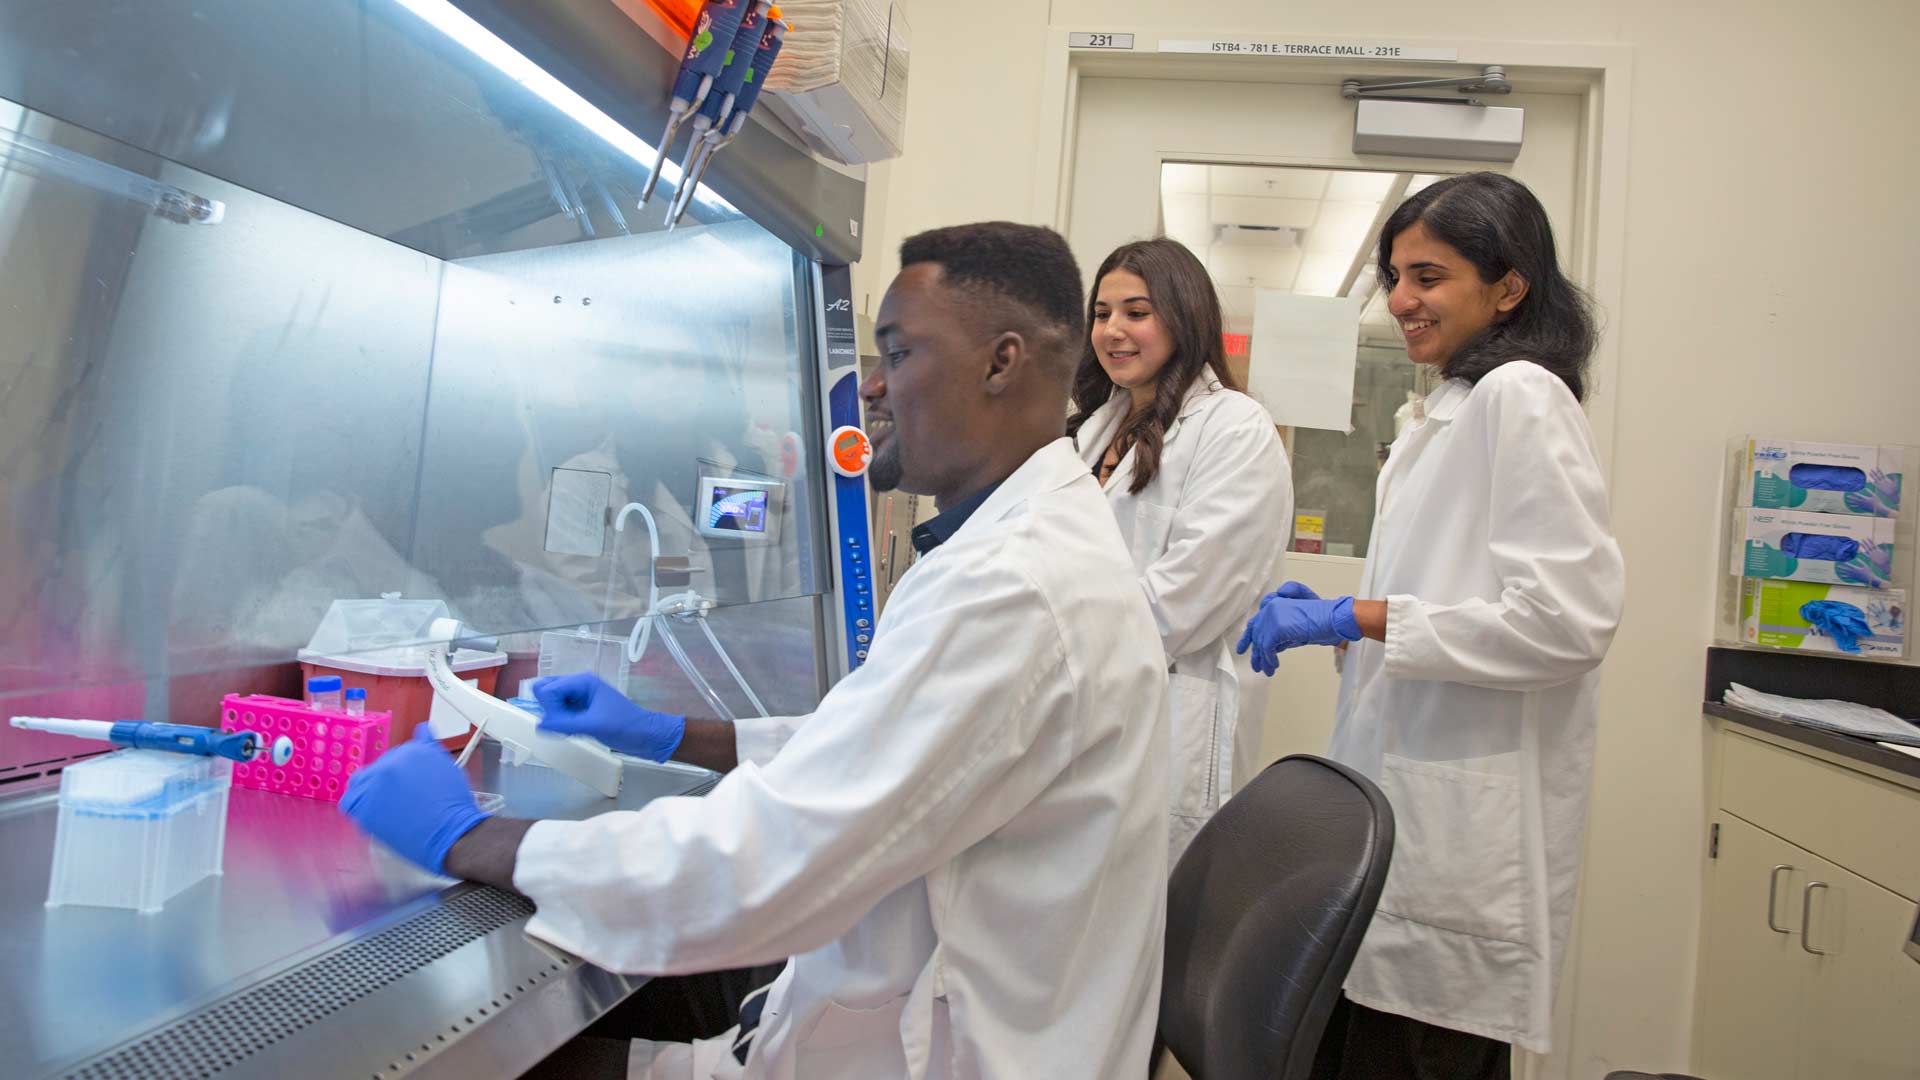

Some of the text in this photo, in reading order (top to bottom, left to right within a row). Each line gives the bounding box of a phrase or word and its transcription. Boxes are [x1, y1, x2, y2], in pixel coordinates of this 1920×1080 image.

[1089, 34, 1113, 46] 231
[1211, 42, 1240, 52] ISTB4
[1250, 43, 1268, 53] 781
[1272, 44, 1281, 53] E.
[1284, 45, 1332, 55] TERRACE
[1335, 46, 1365, 56] MALL
[1375, 47, 1401, 57] 231E
[826, 298, 850, 311] A2
[1222, 333, 1248, 354] EXIT
